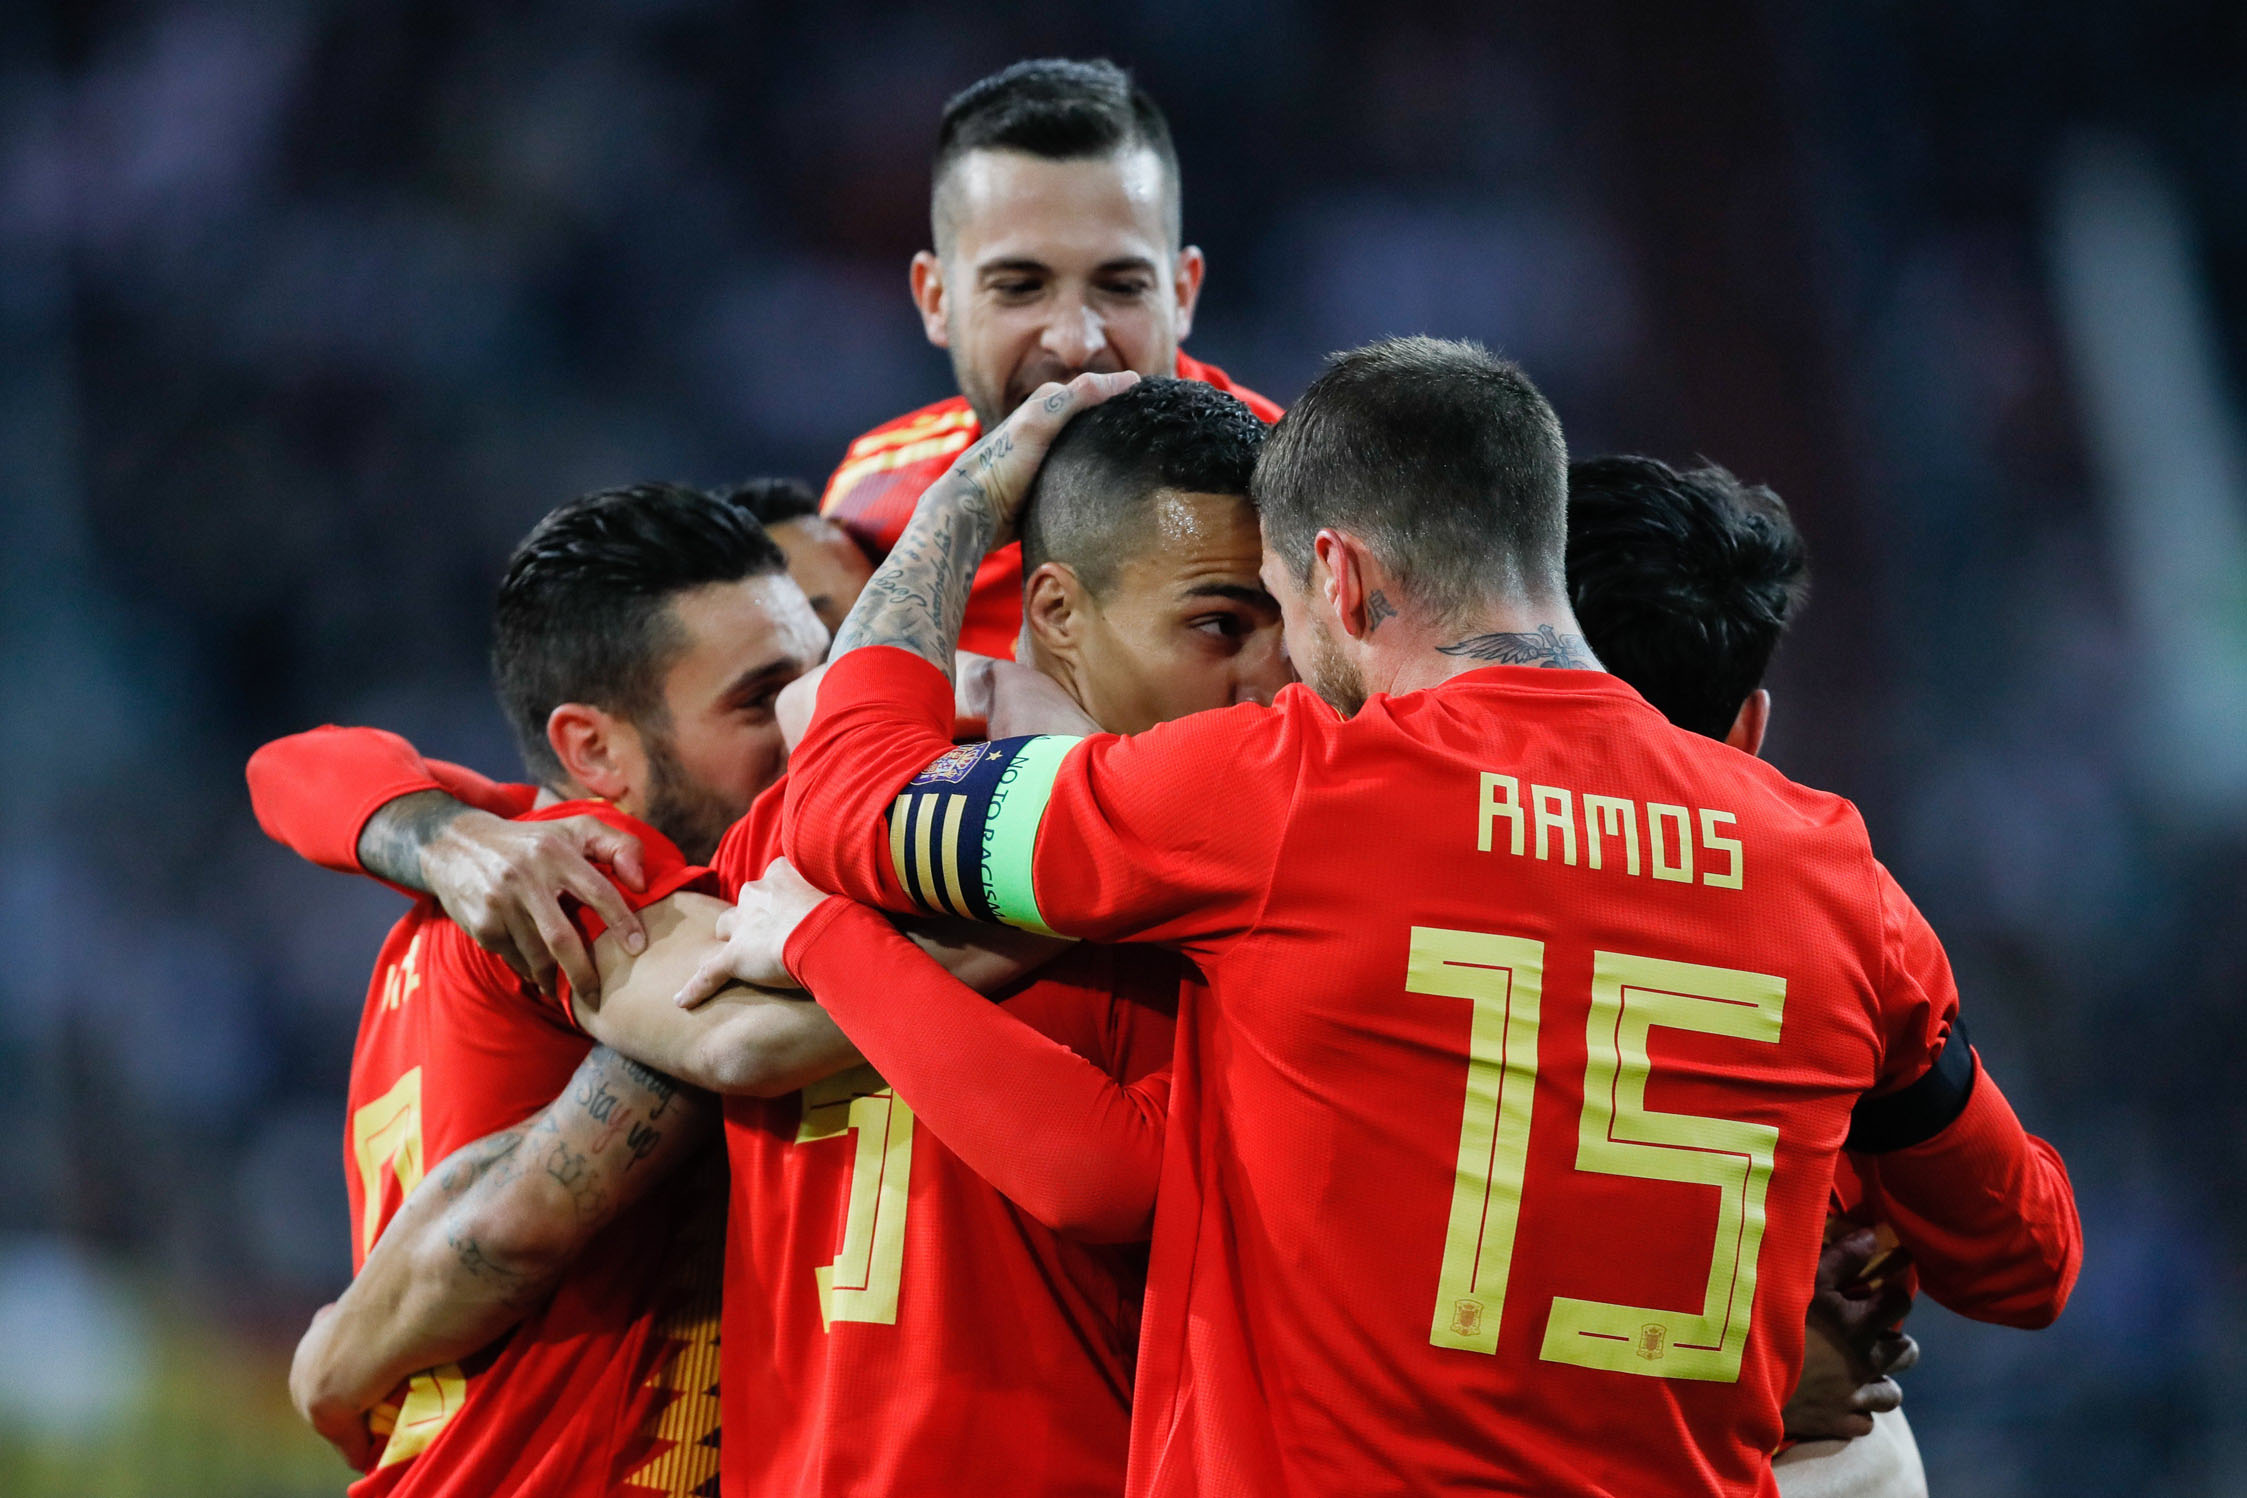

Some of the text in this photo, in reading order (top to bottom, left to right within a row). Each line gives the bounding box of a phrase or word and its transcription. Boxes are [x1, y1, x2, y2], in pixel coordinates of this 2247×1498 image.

[980, 755, 1030, 918] NO TO RACISM
[1477, 771, 1744, 890] RAMOS
[1404, 925, 1787, 1383] 15
